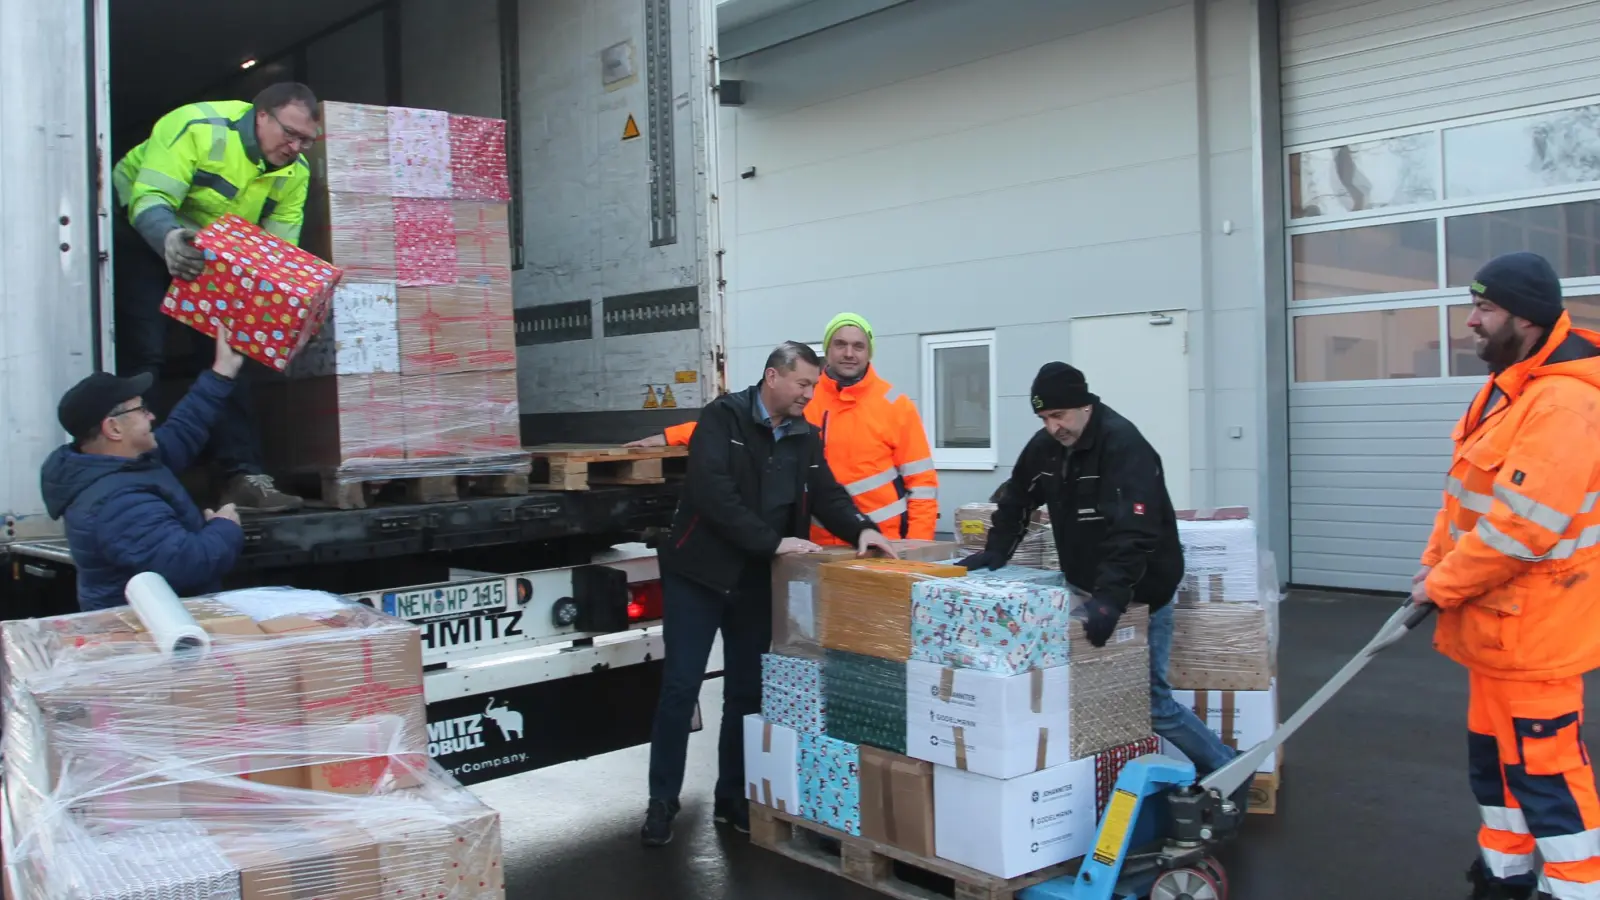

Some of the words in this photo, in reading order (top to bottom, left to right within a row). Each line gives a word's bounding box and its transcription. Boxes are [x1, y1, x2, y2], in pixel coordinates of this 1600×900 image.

[397, 593, 432, 617] NEW
[448, 588, 469, 610] WP
[472, 583, 503, 608] 115
[427, 733, 485, 758] OBULL
